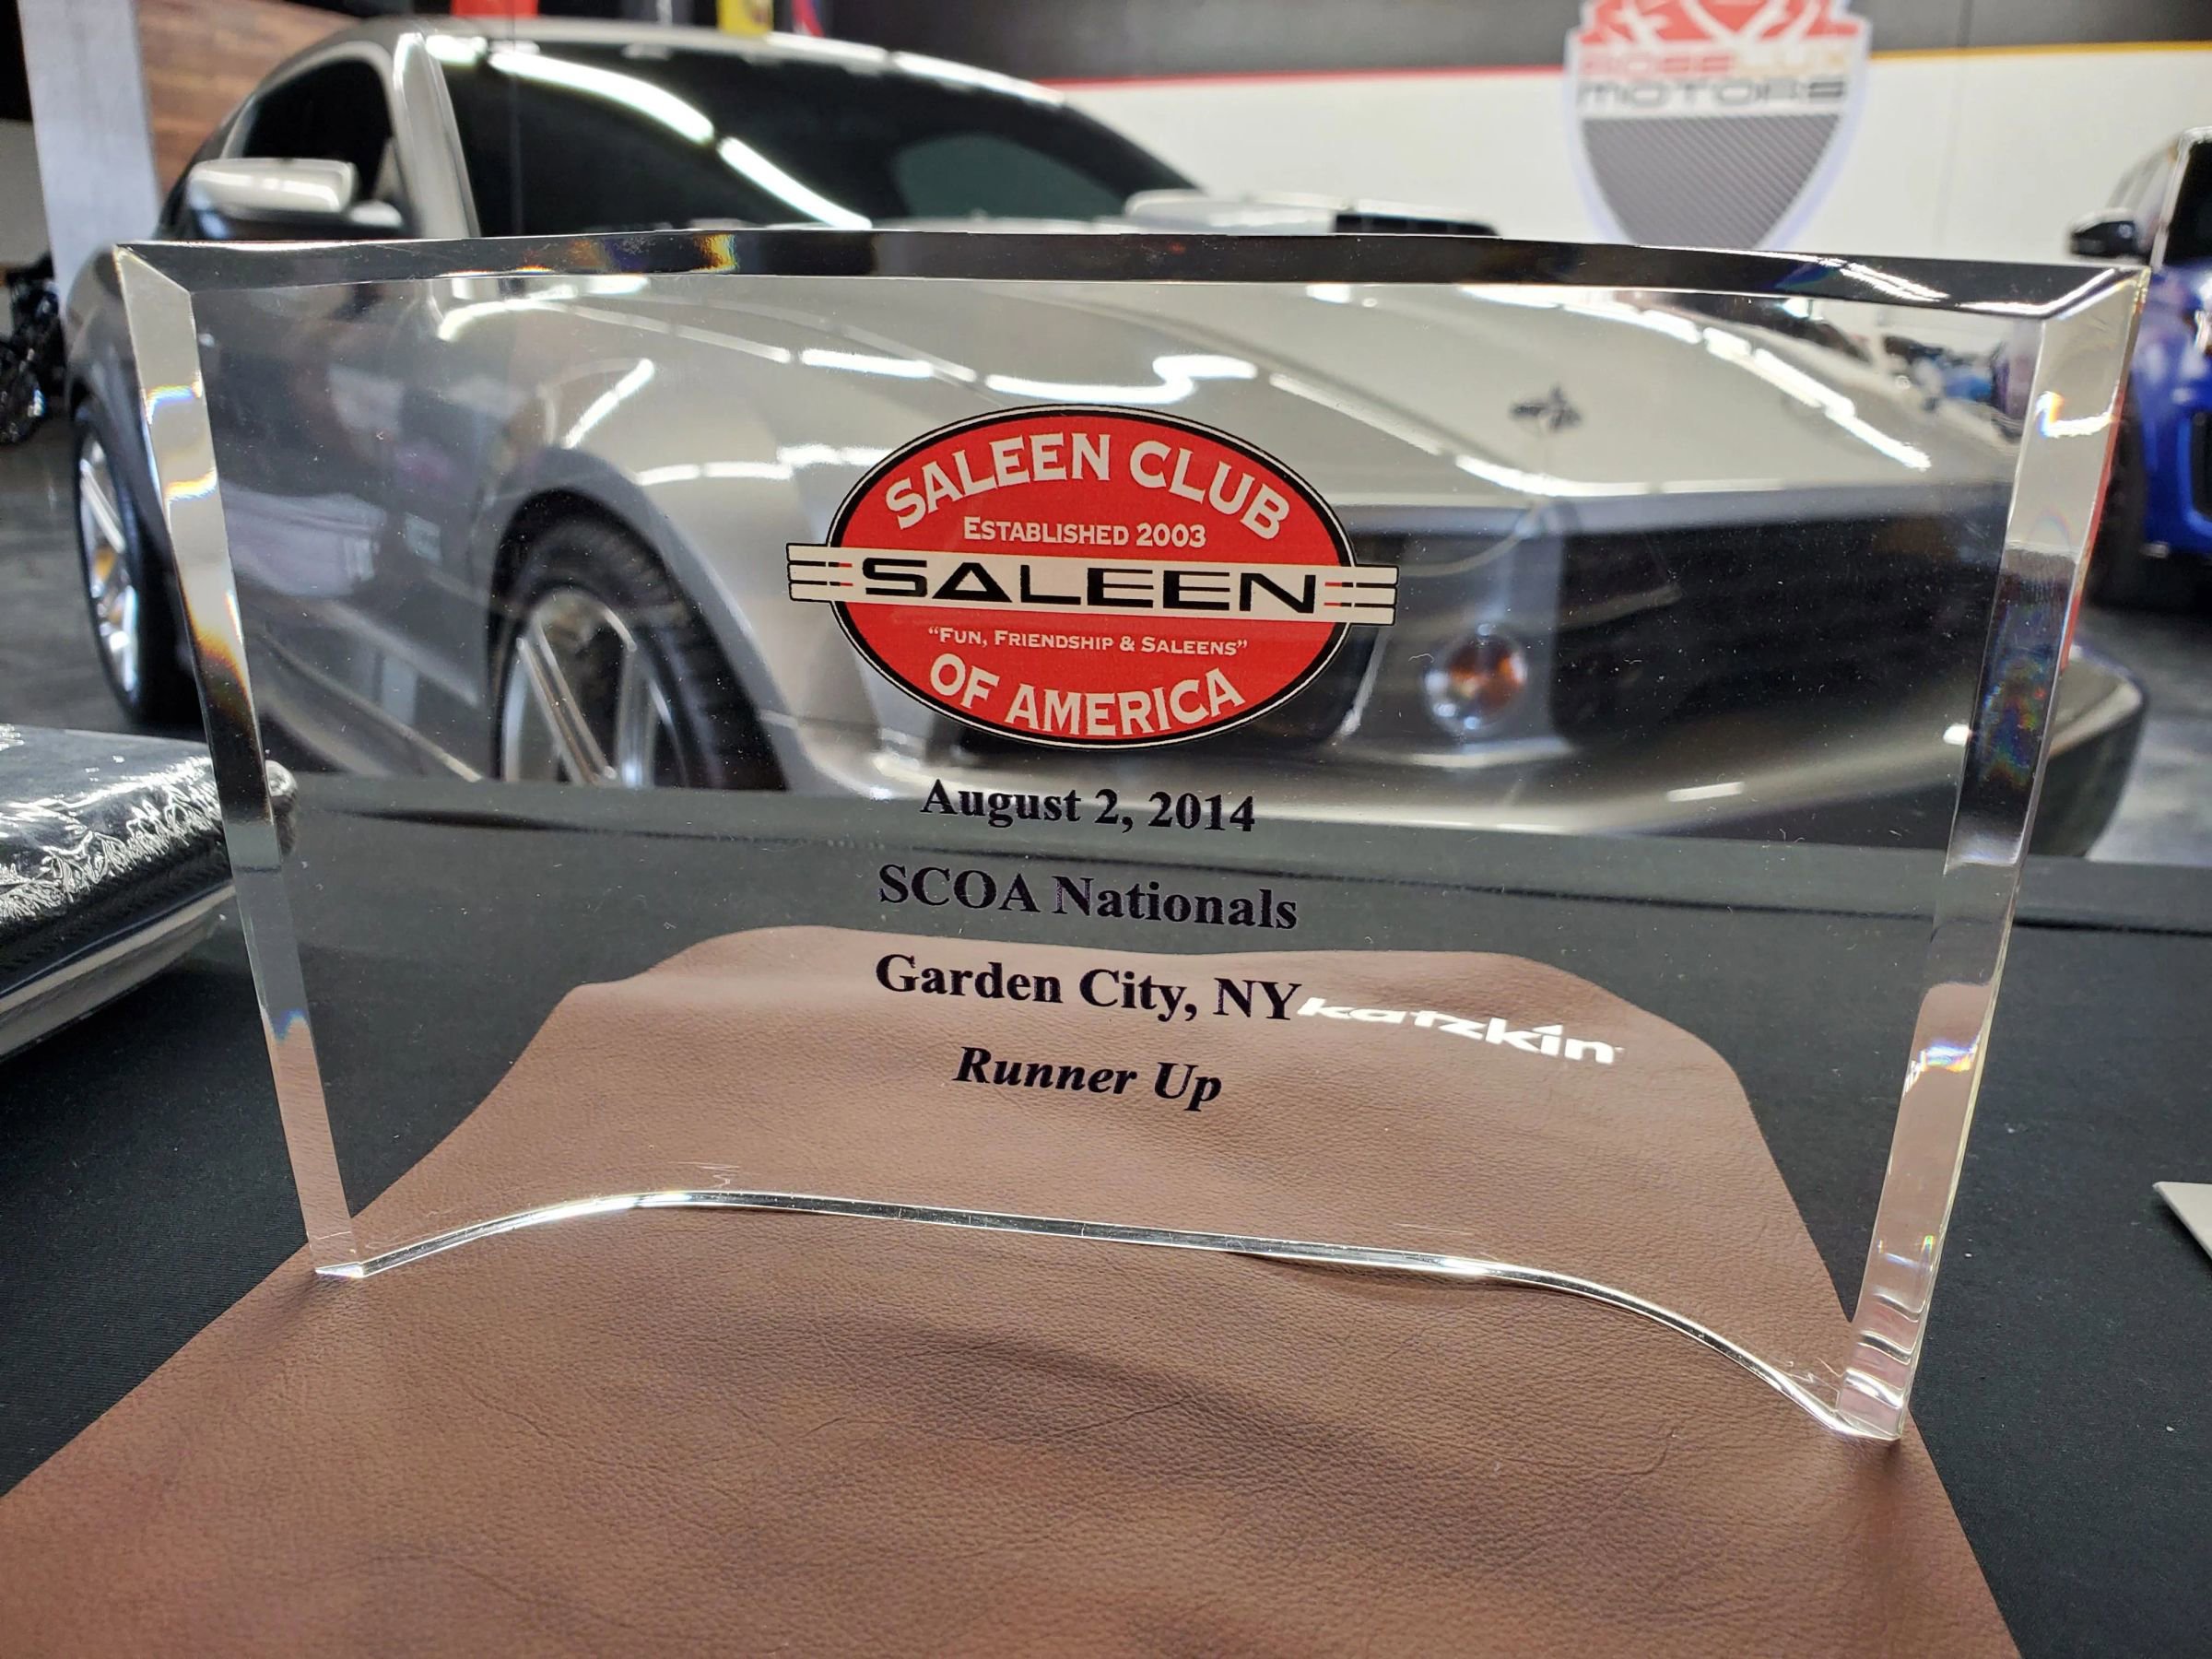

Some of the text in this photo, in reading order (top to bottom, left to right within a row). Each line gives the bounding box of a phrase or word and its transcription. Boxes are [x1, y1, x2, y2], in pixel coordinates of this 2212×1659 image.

[1576, 76, 1846, 107] MOTORS
[886, 433, 1290, 540] SALEEN CLUB
[963, 516, 1206, 548] ESTABLISHED 2003
[862, 557, 1317, 615] SALEEN
[994, 629, 1114, 652] FRIENDSHIP
[1119, 635, 1135, 653] &
[930, 653, 1246, 736] OF AMERICA
[920, 779, 1255, 833] August 2, 2014
[878, 864, 1299, 930] SCOA Nationals
[876, 953, 1302, 1022] Garden City, NY
[1297, 996, 1614, 1065] katzkin
[952, 1045, 1223, 1112] Runner Up
